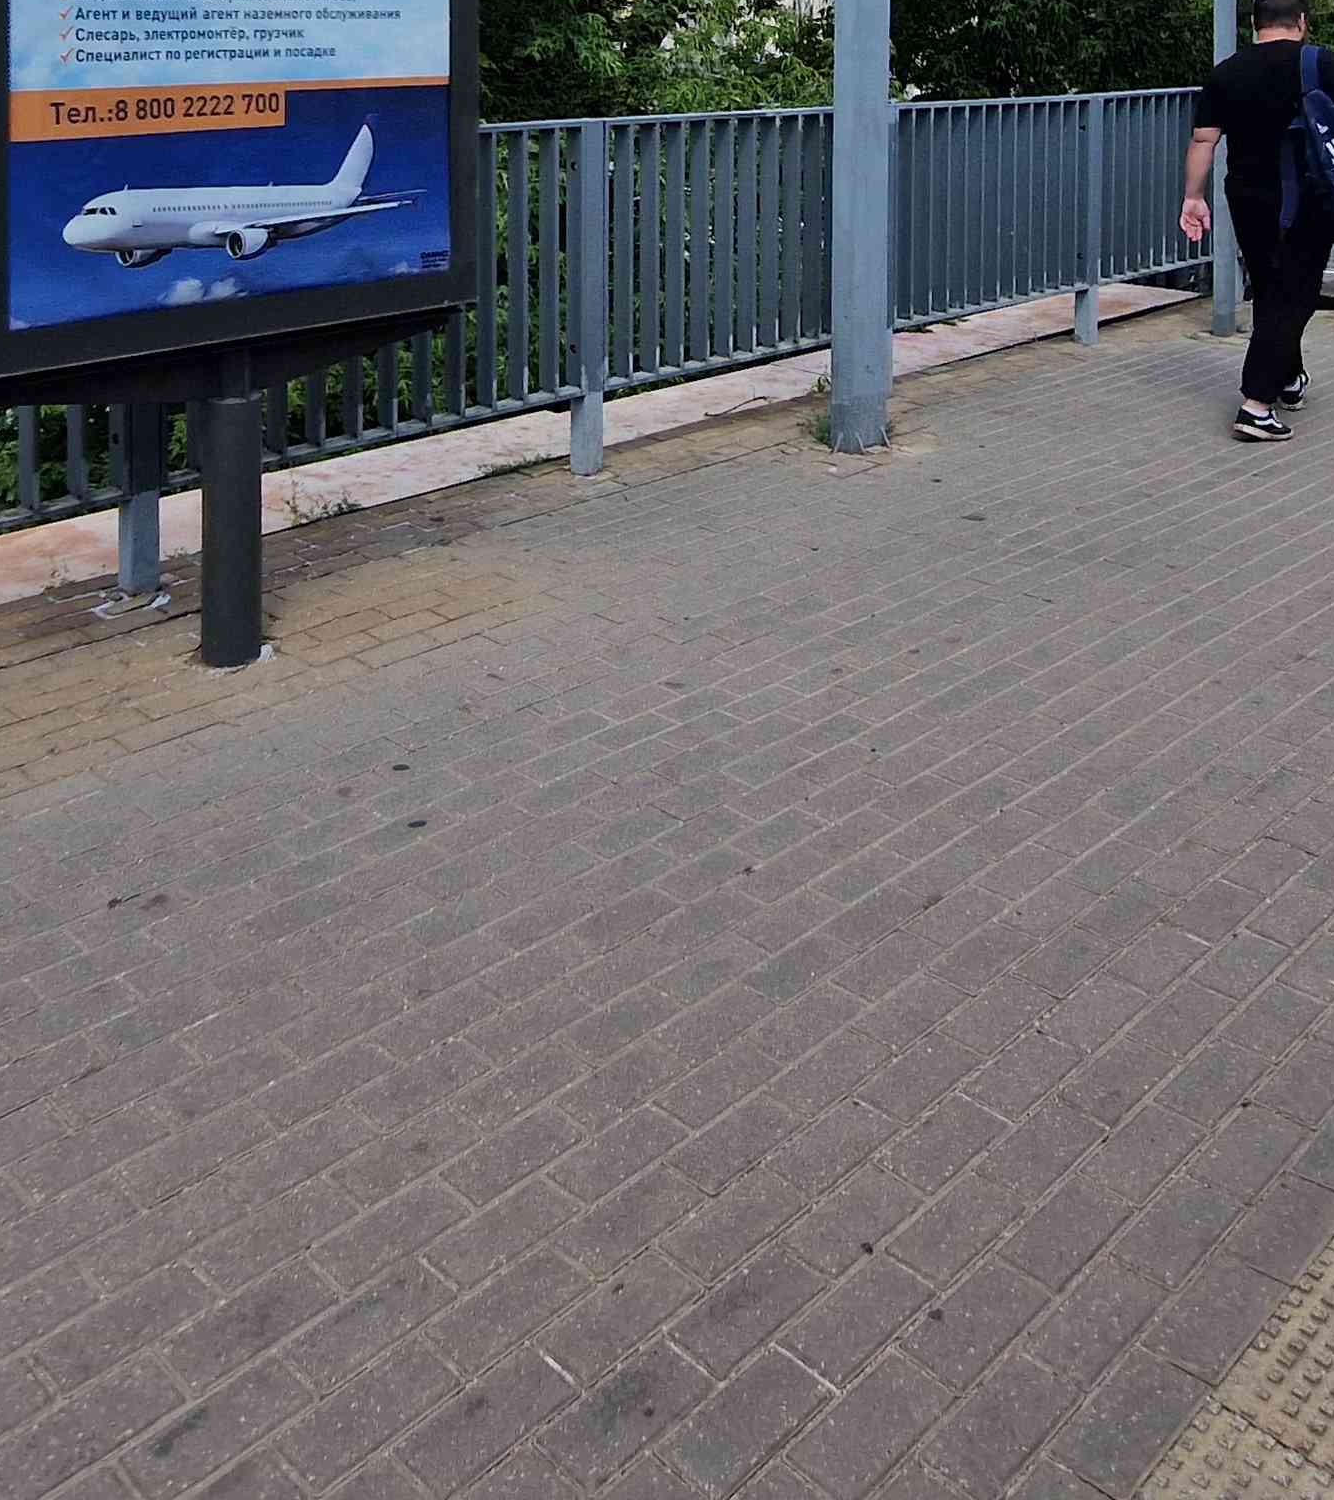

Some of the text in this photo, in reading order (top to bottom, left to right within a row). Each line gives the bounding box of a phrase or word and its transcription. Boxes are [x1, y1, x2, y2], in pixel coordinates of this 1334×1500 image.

[75, 6, 401, 23] Агент и ведущий агент наземного обслуживания
[75, 27, 140, 44] Слесарь,
[253, 28, 305, 41] грузчик
[75, 46, 337, 63] Специалист по регистрации и посадке
[135, 97, 175, 119] 800
[182, 95, 235, 117] 2222
[242, 93, 280, 114] 700
